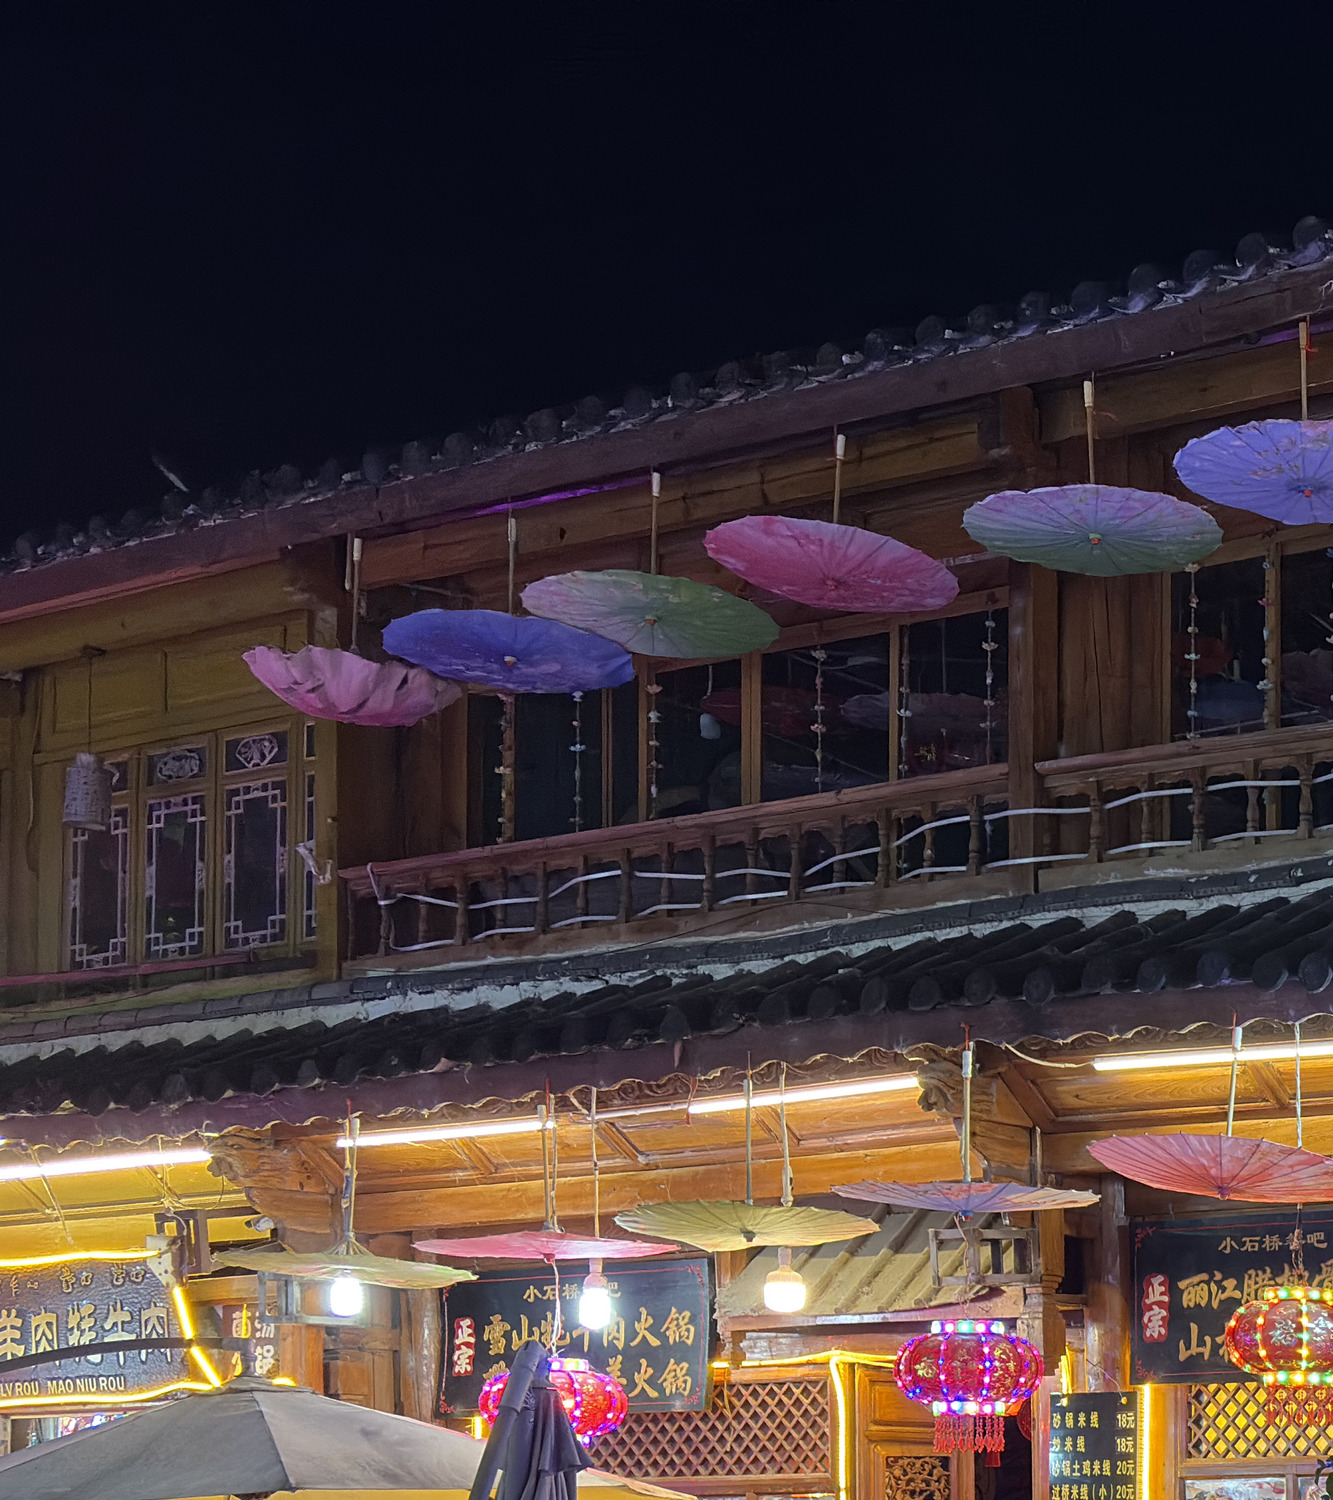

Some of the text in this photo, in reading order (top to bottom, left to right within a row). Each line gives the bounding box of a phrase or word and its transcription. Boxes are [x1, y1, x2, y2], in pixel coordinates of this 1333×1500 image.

[523, 1282, 622, 1303] 小石桥吧
[1144, 1274, 1169, 1339] 正宗
[454, 1320, 476, 1374] 正宗
[15, 1380, 40, 1397] ROU
[47, 1378, 74, 1396] MAO
[76, 1376, 97, 1393] NIU
[99, 1375, 125, 1392] ROU
[1052, 1411, 1135, 1429] 砂锅米线 18元
[1052, 1436, 1135, 1453] 炒米线 18元
[1116, 1460, 1135, 1476] 20元
[1115, 1484, 1135, 1500] 20元
